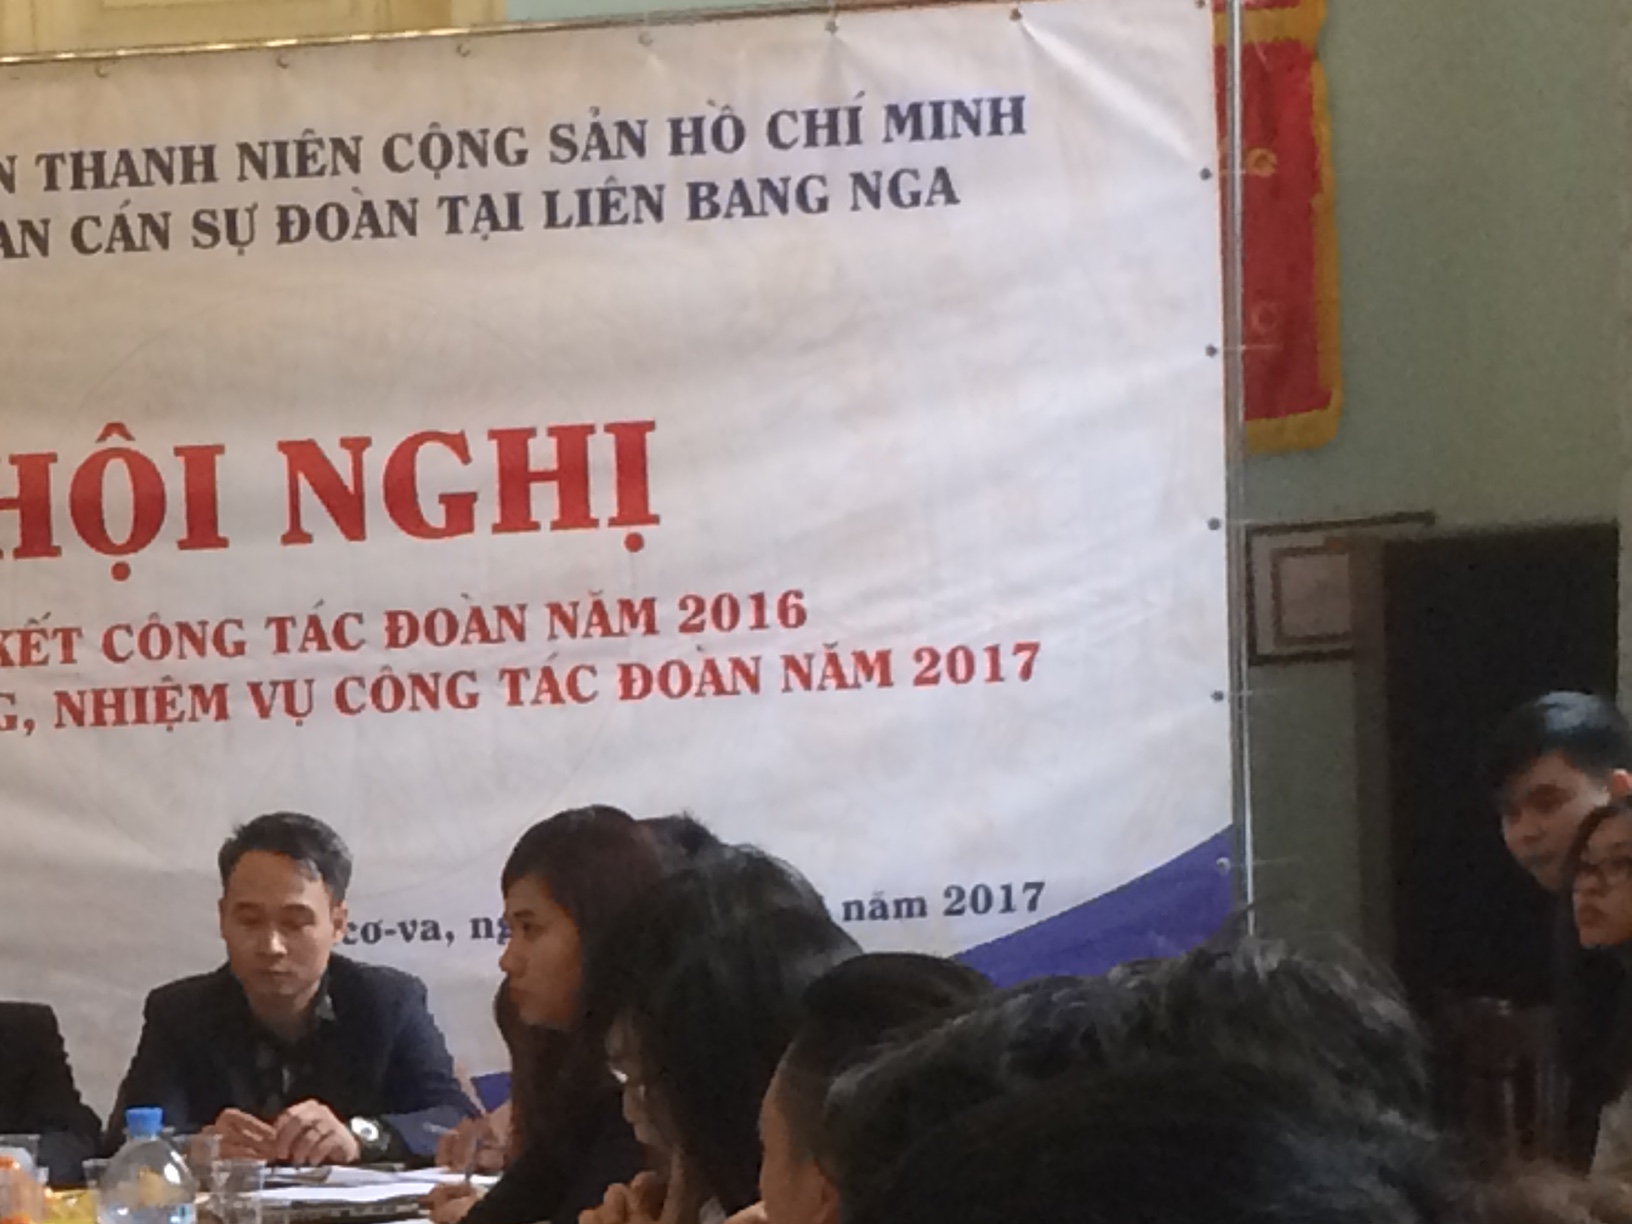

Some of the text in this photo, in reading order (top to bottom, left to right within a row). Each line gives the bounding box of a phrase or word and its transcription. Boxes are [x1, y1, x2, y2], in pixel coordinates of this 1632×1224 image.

[34, 143, 220, 193] THANH
[235, 127, 364, 183] NIÊN
[381, 121, 529, 181] CỘNG
[549, 106, 649, 165] SẢN
[666, 99, 747, 157] HỒ
[765, 90, 866, 152] CHÍ
[881, 94, 1027, 145] MINH
[69, 199, 172, 256] CÁN
[190, 201, 259, 257] SỰ
[274, 185, 420, 246] ĐOÀN
[436, 191, 525, 242] TẠI
[540, 174, 666, 230] LIÊN
[685, 173, 830, 222] BANG
[848, 165, 962, 212] NGA
[276, 419, 661, 554] NGHỊ
[100, 611, 248, 665] CÔNG
[263, 598, 368, 656] TÁC
[382, 592, 529, 651] ĐOÀN
[543, 589, 661, 642] NĂM
[677, 588, 808, 635] 2016
[52, 674, 231, 733] NHIỆM
[245, 677, 316, 727] VỤ
[333, 664, 481, 717] CÔNG
[497, 651, 599, 707] TÁC
[616, 644, 763, 702] ĐOÀN
[779, 640, 895, 694] NĂM
[911, 640, 1042, 688] 2017
[841, 889, 929, 922] năm
[942, 880, 1046, 917] 2017
